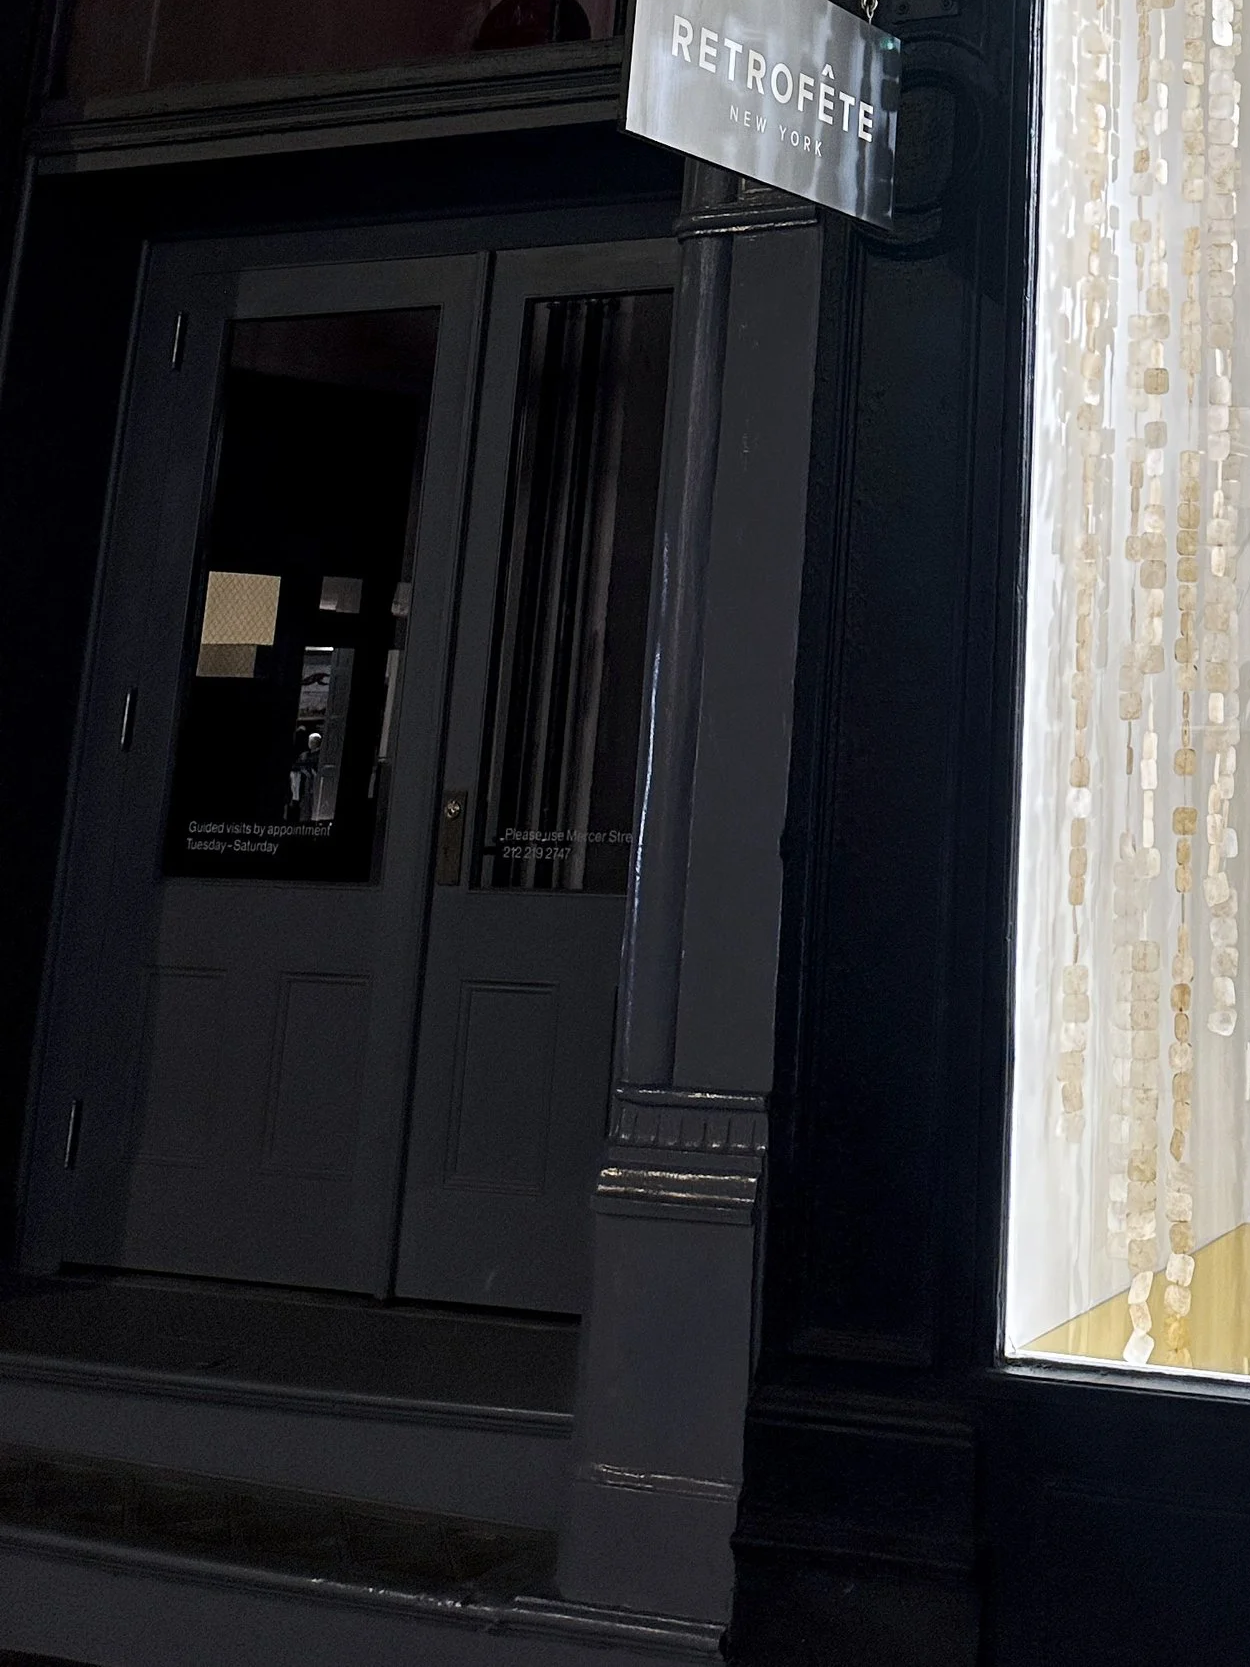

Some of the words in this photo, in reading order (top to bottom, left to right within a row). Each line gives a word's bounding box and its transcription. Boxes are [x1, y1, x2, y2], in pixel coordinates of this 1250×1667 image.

[671, 14, 874, 143] RETROFÊTE
[729, 104, 767, 134] NEW
[780, 124, 823, 157] YORK
[188, 820, 225, 834] Guided
[226, 822, 252, 835] visits
[253, 823, 266, 837] by
[267, 824, 332, 837] appointment
[505, 827, 543, 842] Please
[544, 830, 564, 842] use
[503, 846, 522, 859] 212
[524, 846, 543, 860] 219
[544, 846, 572, 861] 2747
